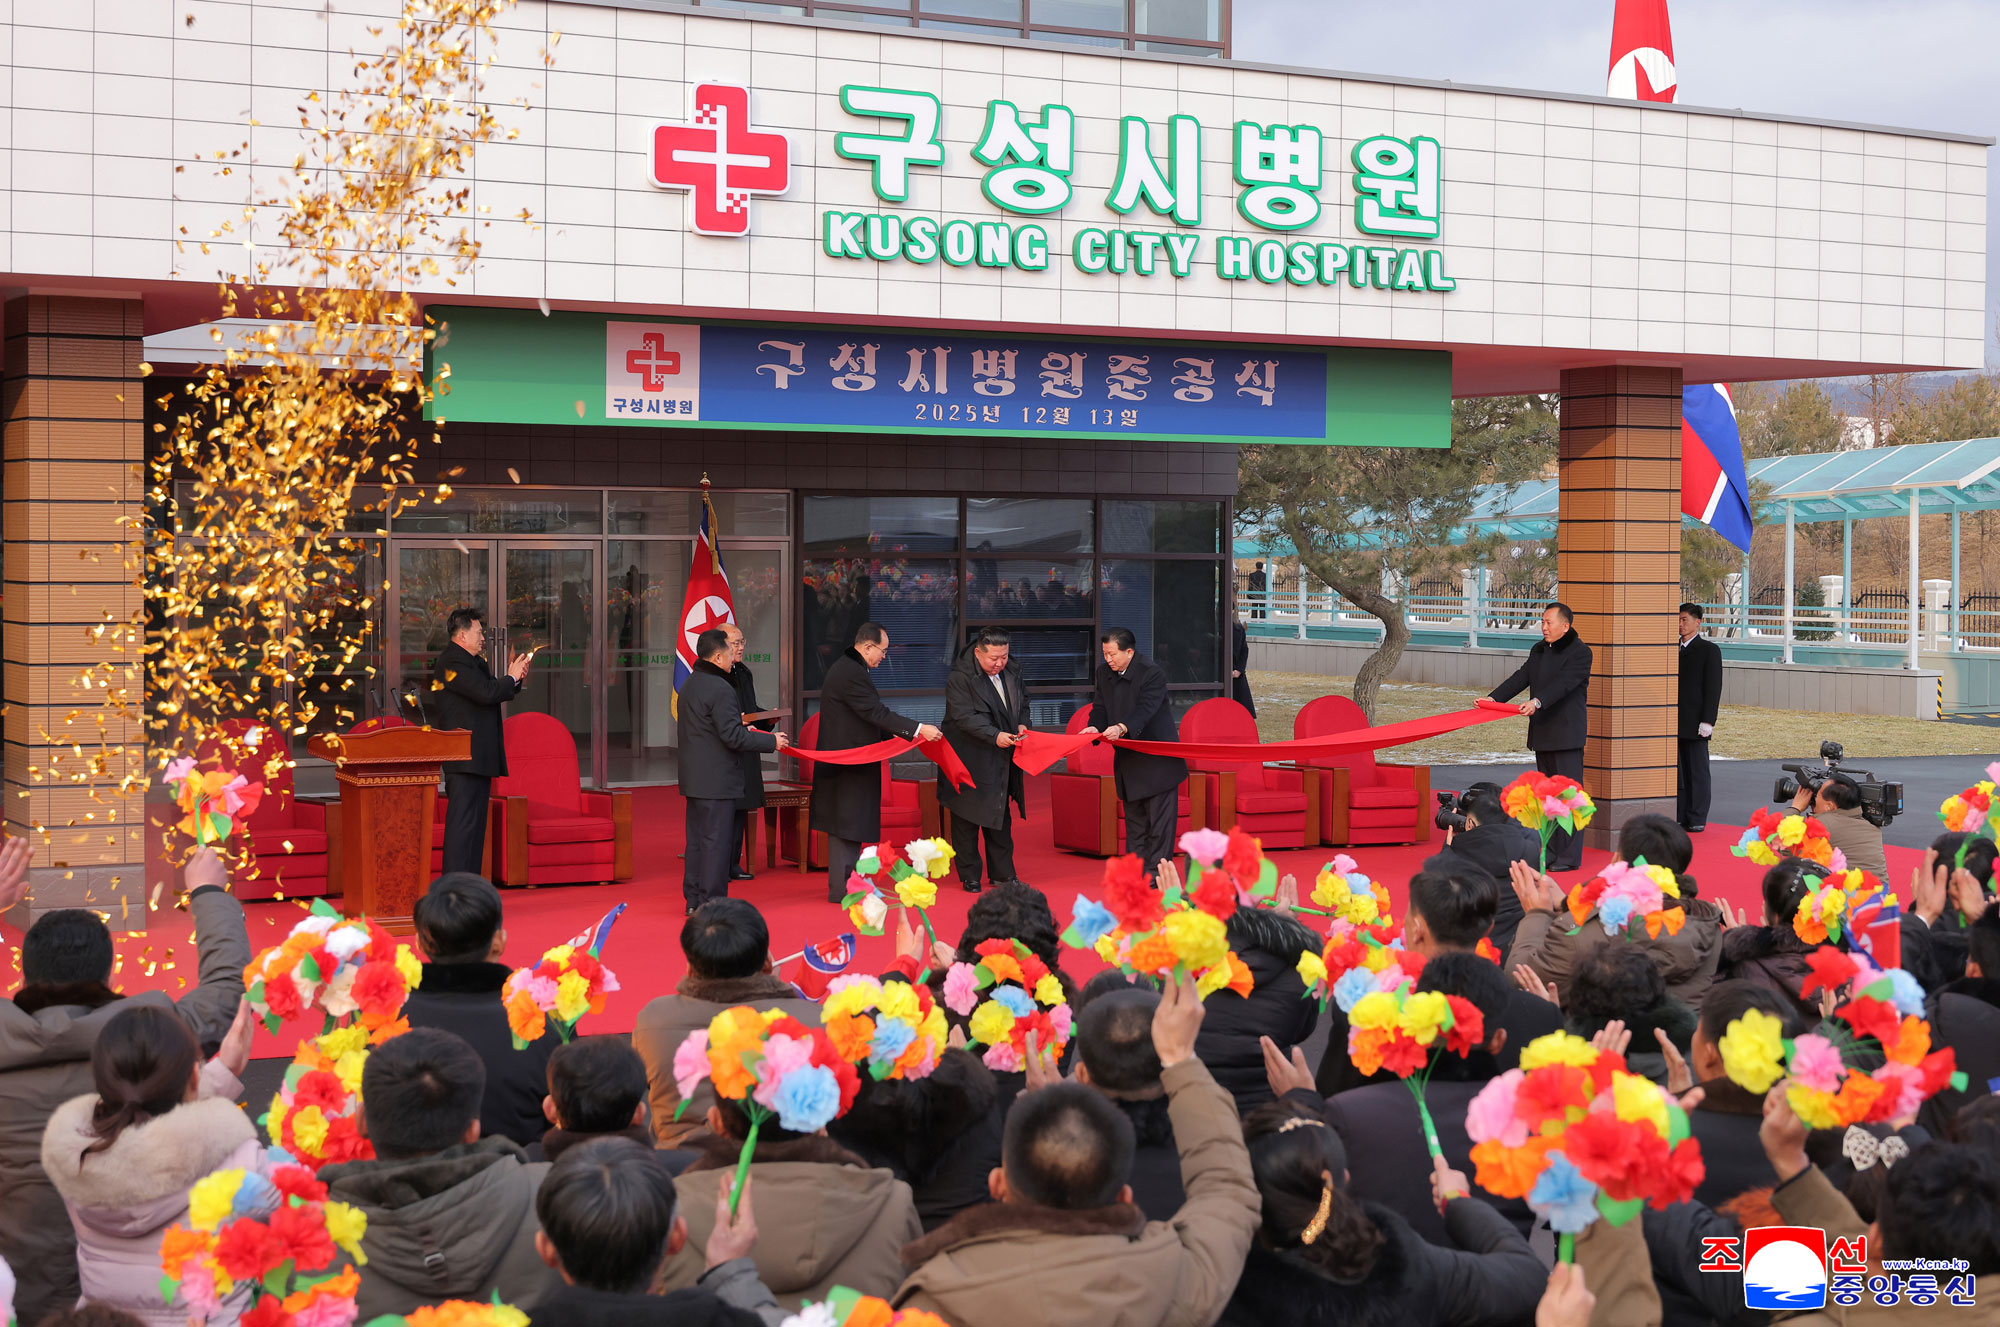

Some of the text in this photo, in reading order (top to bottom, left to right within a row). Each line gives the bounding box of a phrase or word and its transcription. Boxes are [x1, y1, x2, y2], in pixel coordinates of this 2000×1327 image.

[834, 84, 1441, 239] 구성시병원
[823, 210, 1457, 292] KUSONG CITY HOSPITAL
[613, 398, 693, 415] 구성시병원
[915, 403, 1139, 427] 2025년 12월 13일
